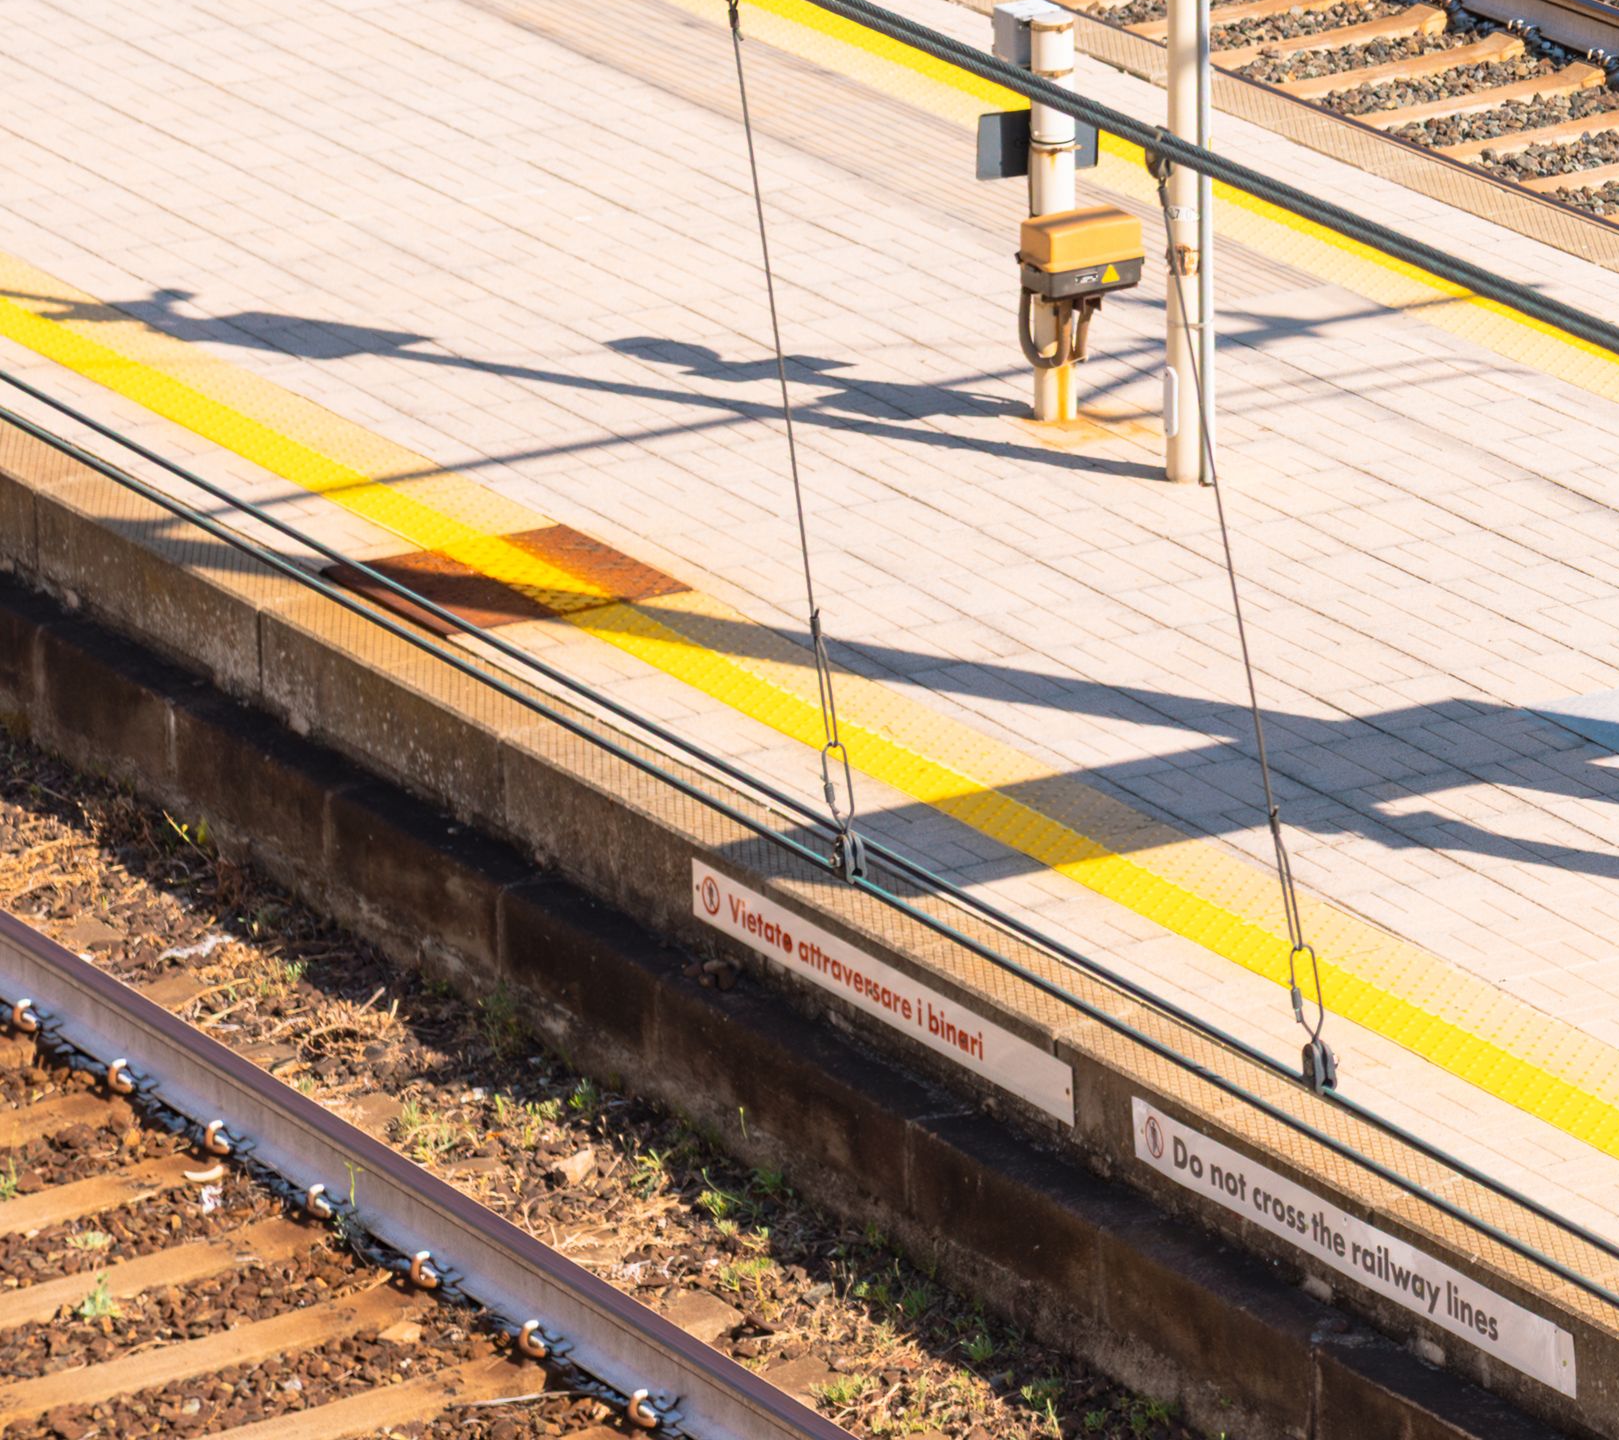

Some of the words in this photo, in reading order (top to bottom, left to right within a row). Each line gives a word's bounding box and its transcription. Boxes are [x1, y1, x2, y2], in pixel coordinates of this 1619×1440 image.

[728, 894, 793, 954] Vietato
[798, 941, 912, 1020] attraversare
[916, 998, 924, 1026] i
[928, 1002, 984, 1061] binari
[1172, 1136, 1204, 1179] Do
[1210, 1160, 1247, 1200] not
[1252, 1185, 1307, 1234] cross
[1311, 1211, 1347, 1258] the
[1351, 1240, 1441, 1315] railway
[1445, 1280, 1499, 1342] lines
